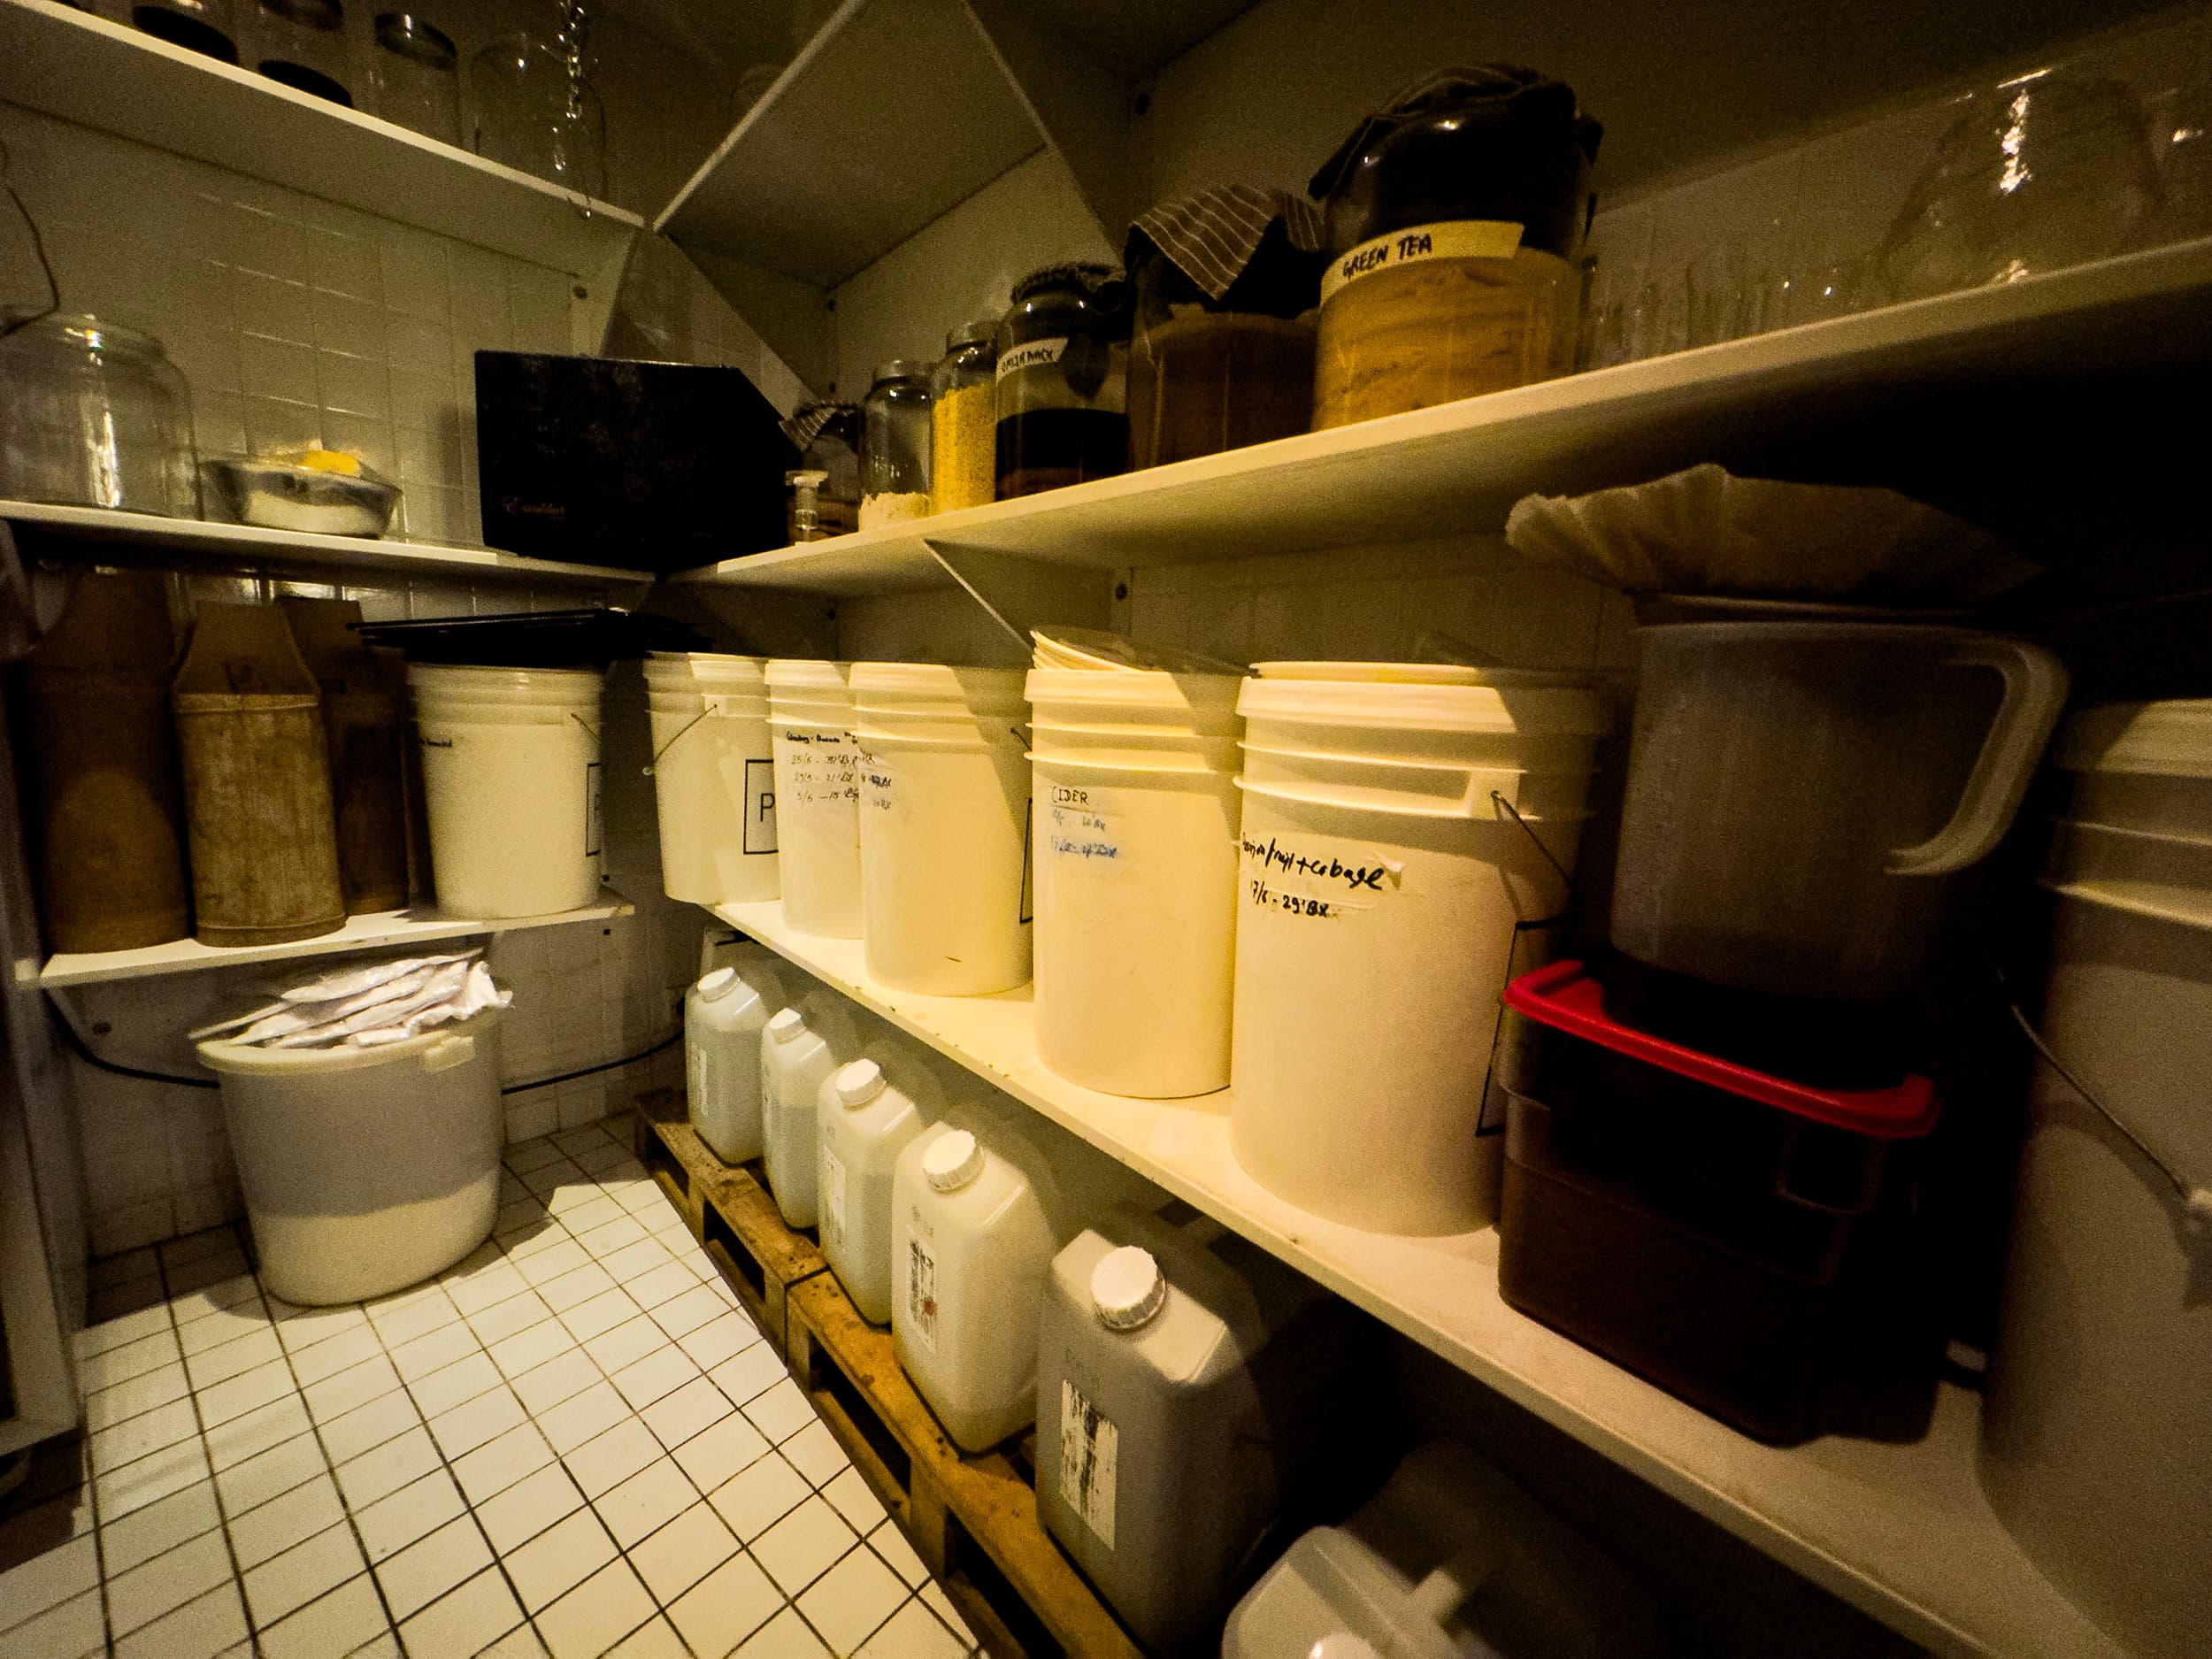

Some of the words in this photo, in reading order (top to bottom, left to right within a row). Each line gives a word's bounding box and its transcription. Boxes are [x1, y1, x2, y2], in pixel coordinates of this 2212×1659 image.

[1343, 245, 1389, 280] GREEN
[1398, 234, 1432, 260] TEA
[760, 793, 775, 822] P
[1052, 786, 1089, 806] CIDER
